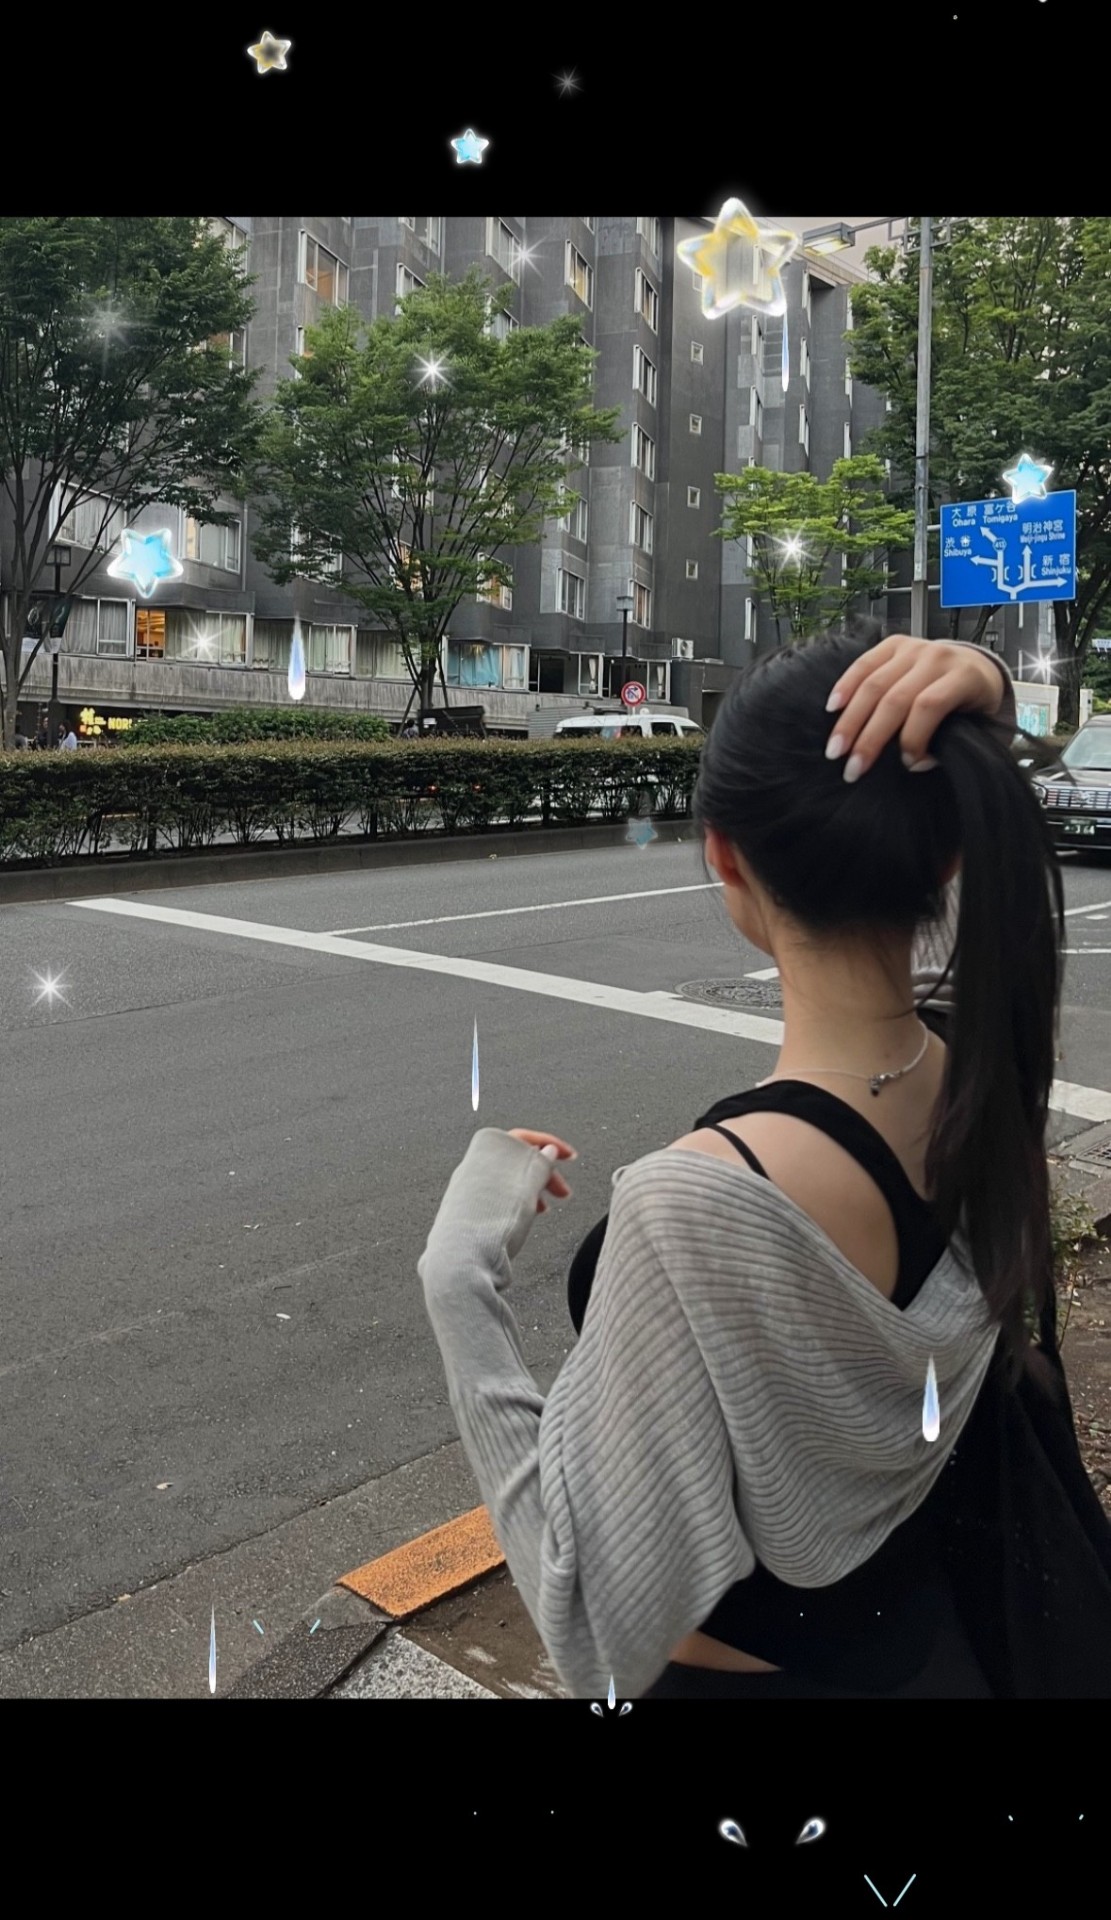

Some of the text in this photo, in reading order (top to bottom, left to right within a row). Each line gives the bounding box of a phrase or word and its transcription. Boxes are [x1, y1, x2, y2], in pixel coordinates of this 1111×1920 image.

[952, 505, 976, 518] 大原
[983, 514, 1018, 524] Tomigaya
[1022, 520, 1063, 533] 明治神宮
[944, 548, 972, 557] Shibuya
[1043, 553, 1070, 565] 新宿
[1041, 566, 1071, 576] Shinjuku
